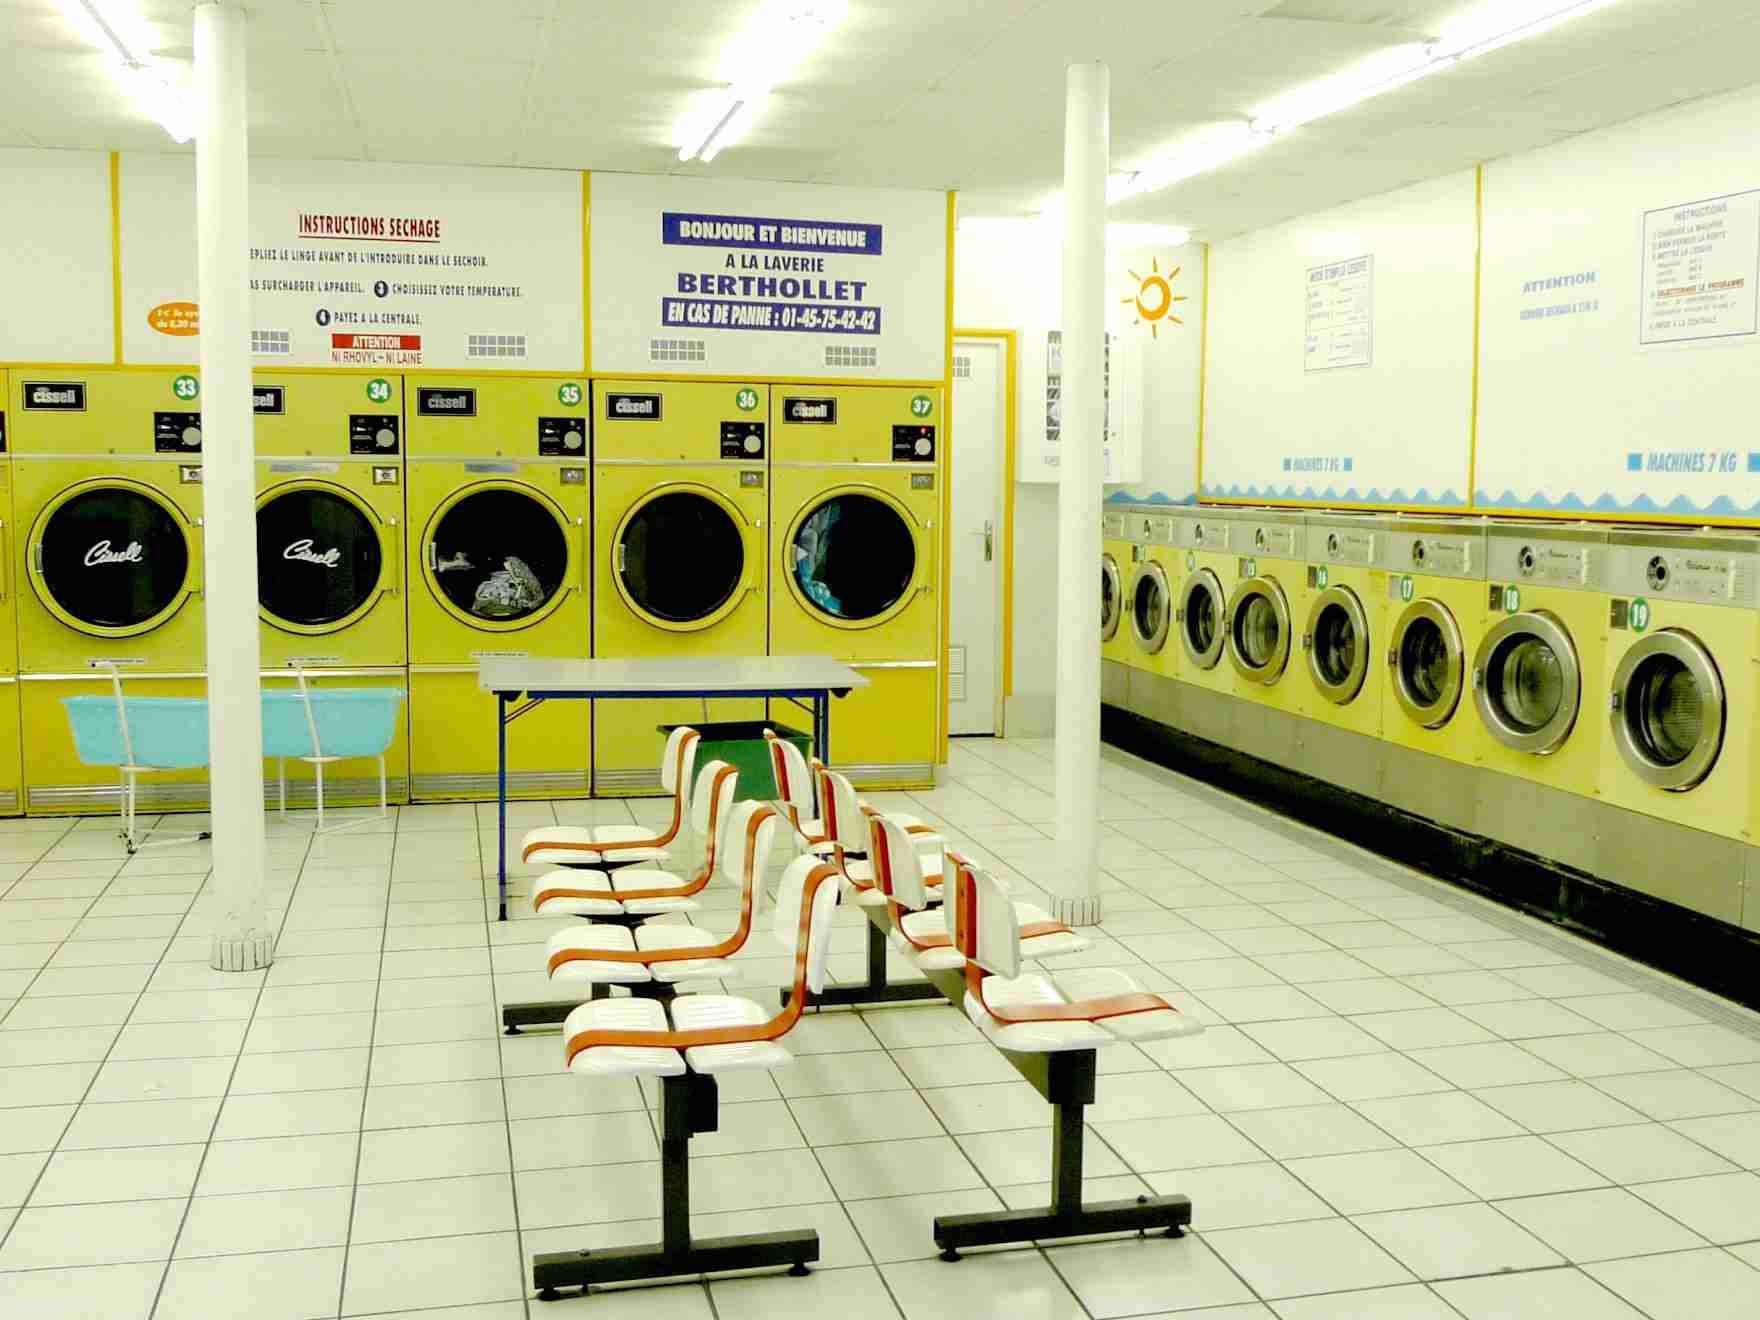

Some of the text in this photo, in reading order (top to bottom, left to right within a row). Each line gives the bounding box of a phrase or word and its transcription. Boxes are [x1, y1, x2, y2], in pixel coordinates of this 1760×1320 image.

[299, 213, 441, 238] INSTRUCTIONS SECHAGE
[679, 220, 867, 247] BONJOUR ET BIENVENUE
[250, 248, 276, 261] EPLIEZ
[279, 249, 289, 261] LE
[291, 249, 316, 262] LINGE
[319, 250, 345, 263] AVANT
[348, 252, 358, 263] DE
[360, 252, 415, 265] L'INTRODUIRE
[418, 254, 439, 266] DANS
[442, 255, 451, 266] LE
[725, 253, 825, 273] A LA LAVERIE
[250, 280, 260, 291] AS
[262, 280, 314, 292] SURCHARGER
[392, 283, 438, 296] CHOISISSEZ
[440, 284, 465, 297] VOTRE
[677, 272, 867, 302] BERTHOLLET
[1522, 272, 1597, 294] ATTENTION
[334, 312, 357, 324] PAYEZ
[361, 313, 366, 324] A
[369, 313, 379, 324] LA
[668, 302, 684, 322] EN
[687, 303, 709, 323] CAS
[712, 304, 730, 325] DE
[731, 305, 771, 326] PANNE
[782, 306, 876, 330] 01-45-75-42-42
[352, 335, 401, 349] ATTENTION
[343, 352, 377, 364] RHOVYL
[397, 353, 422, 365] LAINE
[32, 388, 76, 404] cissell
[176, 379, 195, 397] 33
[370, 382, 389, 400] 34
[561, 386, 579, 403] 35
[427, 394, 466, 409] cissell
[739, 391, 756, 408] 36
[912, 399, 931, 414] 37
[1648, 452, 1737, 472] MACHINES 7 KG
[1402, 579, 1413, 599] 17
[1506, 589, 1519, 610] 18
[1631, 603, 1648, 627] 19
